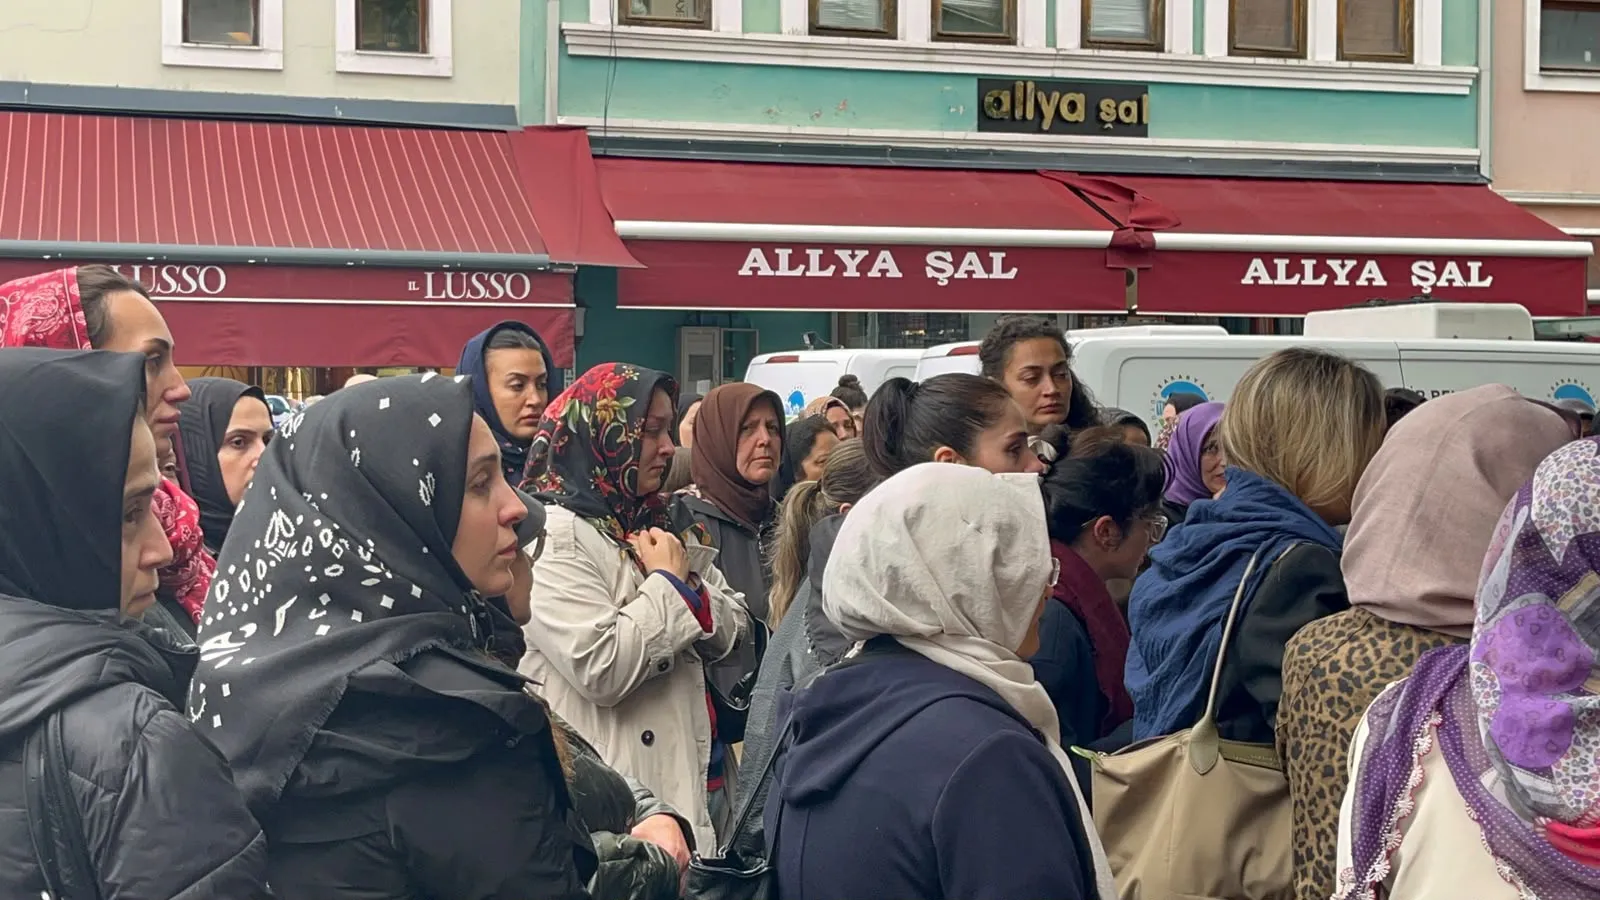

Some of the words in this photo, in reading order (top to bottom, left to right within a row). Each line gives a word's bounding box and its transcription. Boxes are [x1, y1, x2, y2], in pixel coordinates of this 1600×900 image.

[983, 80, 1086, 131] allya
[1099, 93, 1149, 129] şal
[408, 281, 420, 291] IL
[424, 271, 531, 300] LUSSO
[738, 248, 903, 277] ALLYA
[925, 251, 1018, 286] ŞAL
[1241, 258, 1387, 286] ALLYA
[1410, 260, 1493, 294] ŞAL
